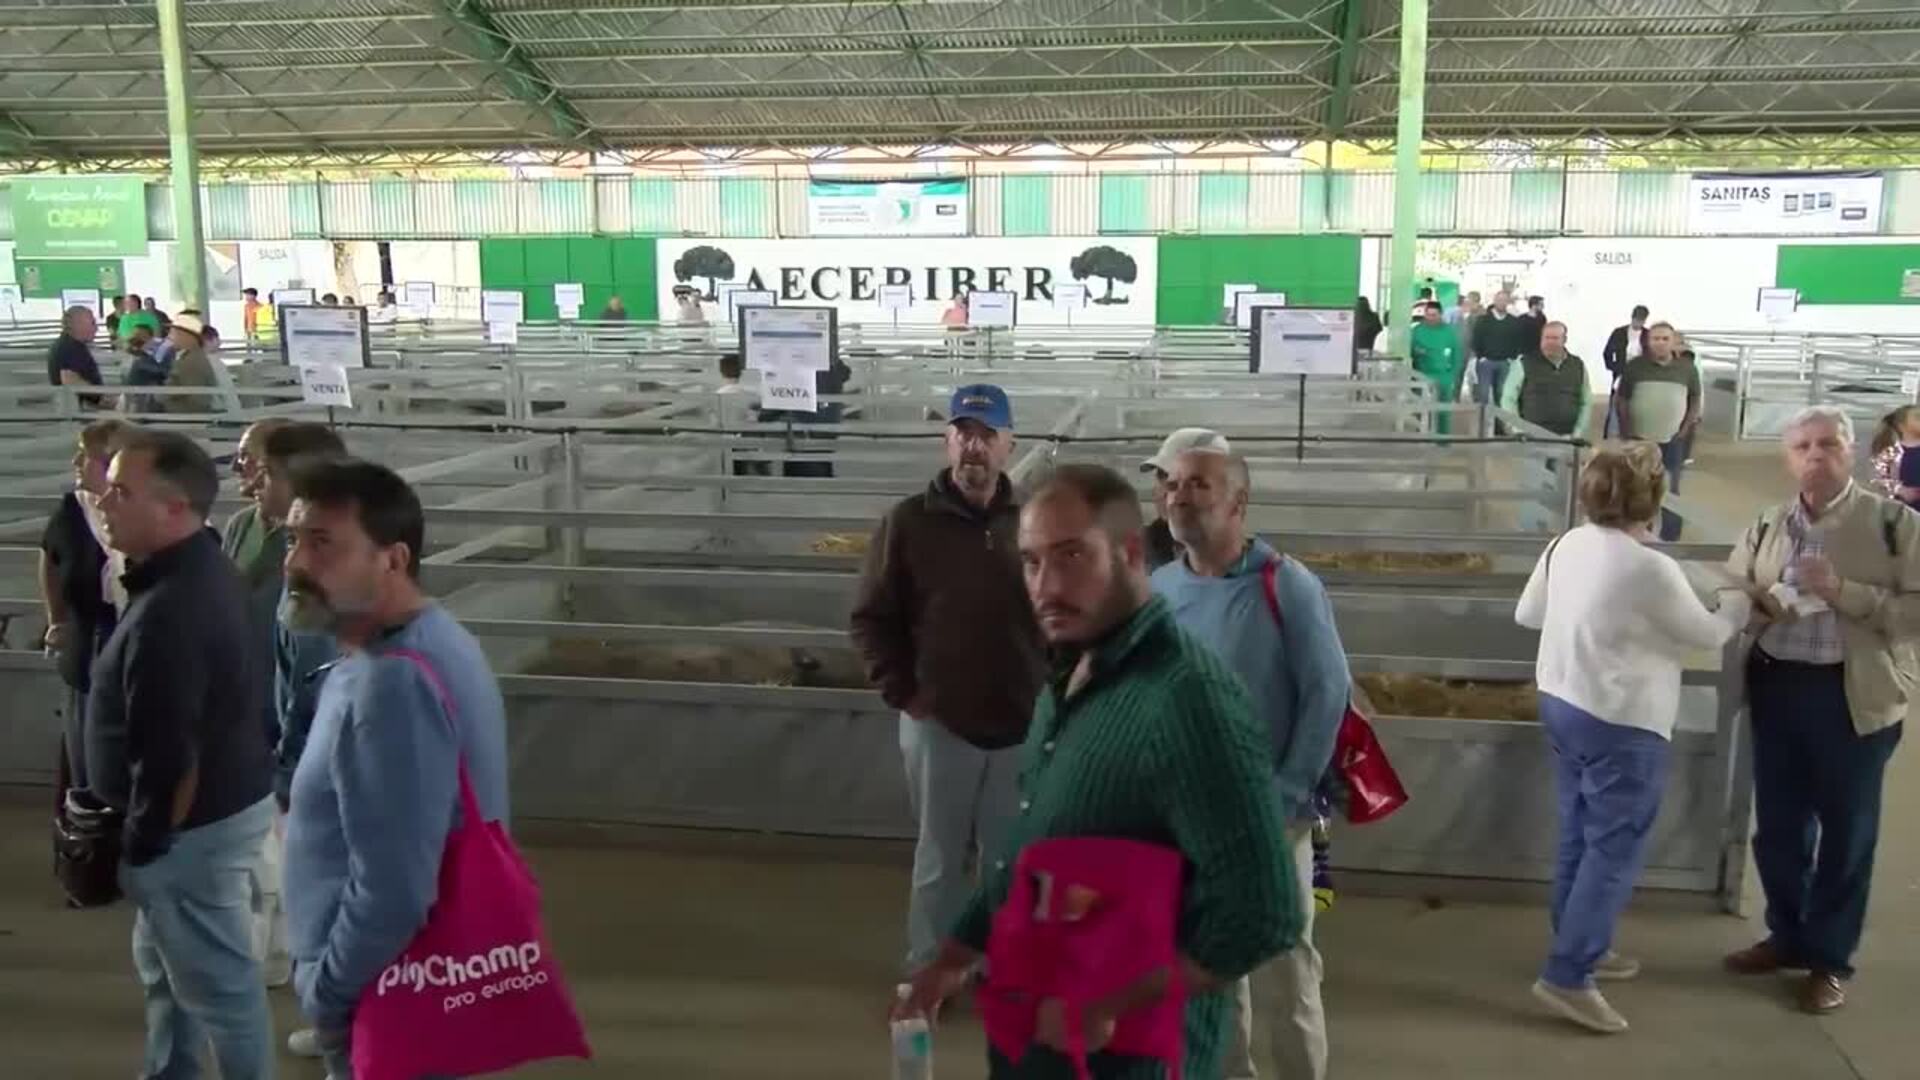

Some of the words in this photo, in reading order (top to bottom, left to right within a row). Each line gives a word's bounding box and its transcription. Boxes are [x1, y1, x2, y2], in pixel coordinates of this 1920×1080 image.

[1701, 186, 1771, 202] SANITAS
[1595, 252, 1632, 265] SALIDA
[311, 384, 346, 395] VENTA
[770, 387, 810, 398] VENTA
[443, 991, 476, 1014] pro
[481, 971, 548, 998] europa
